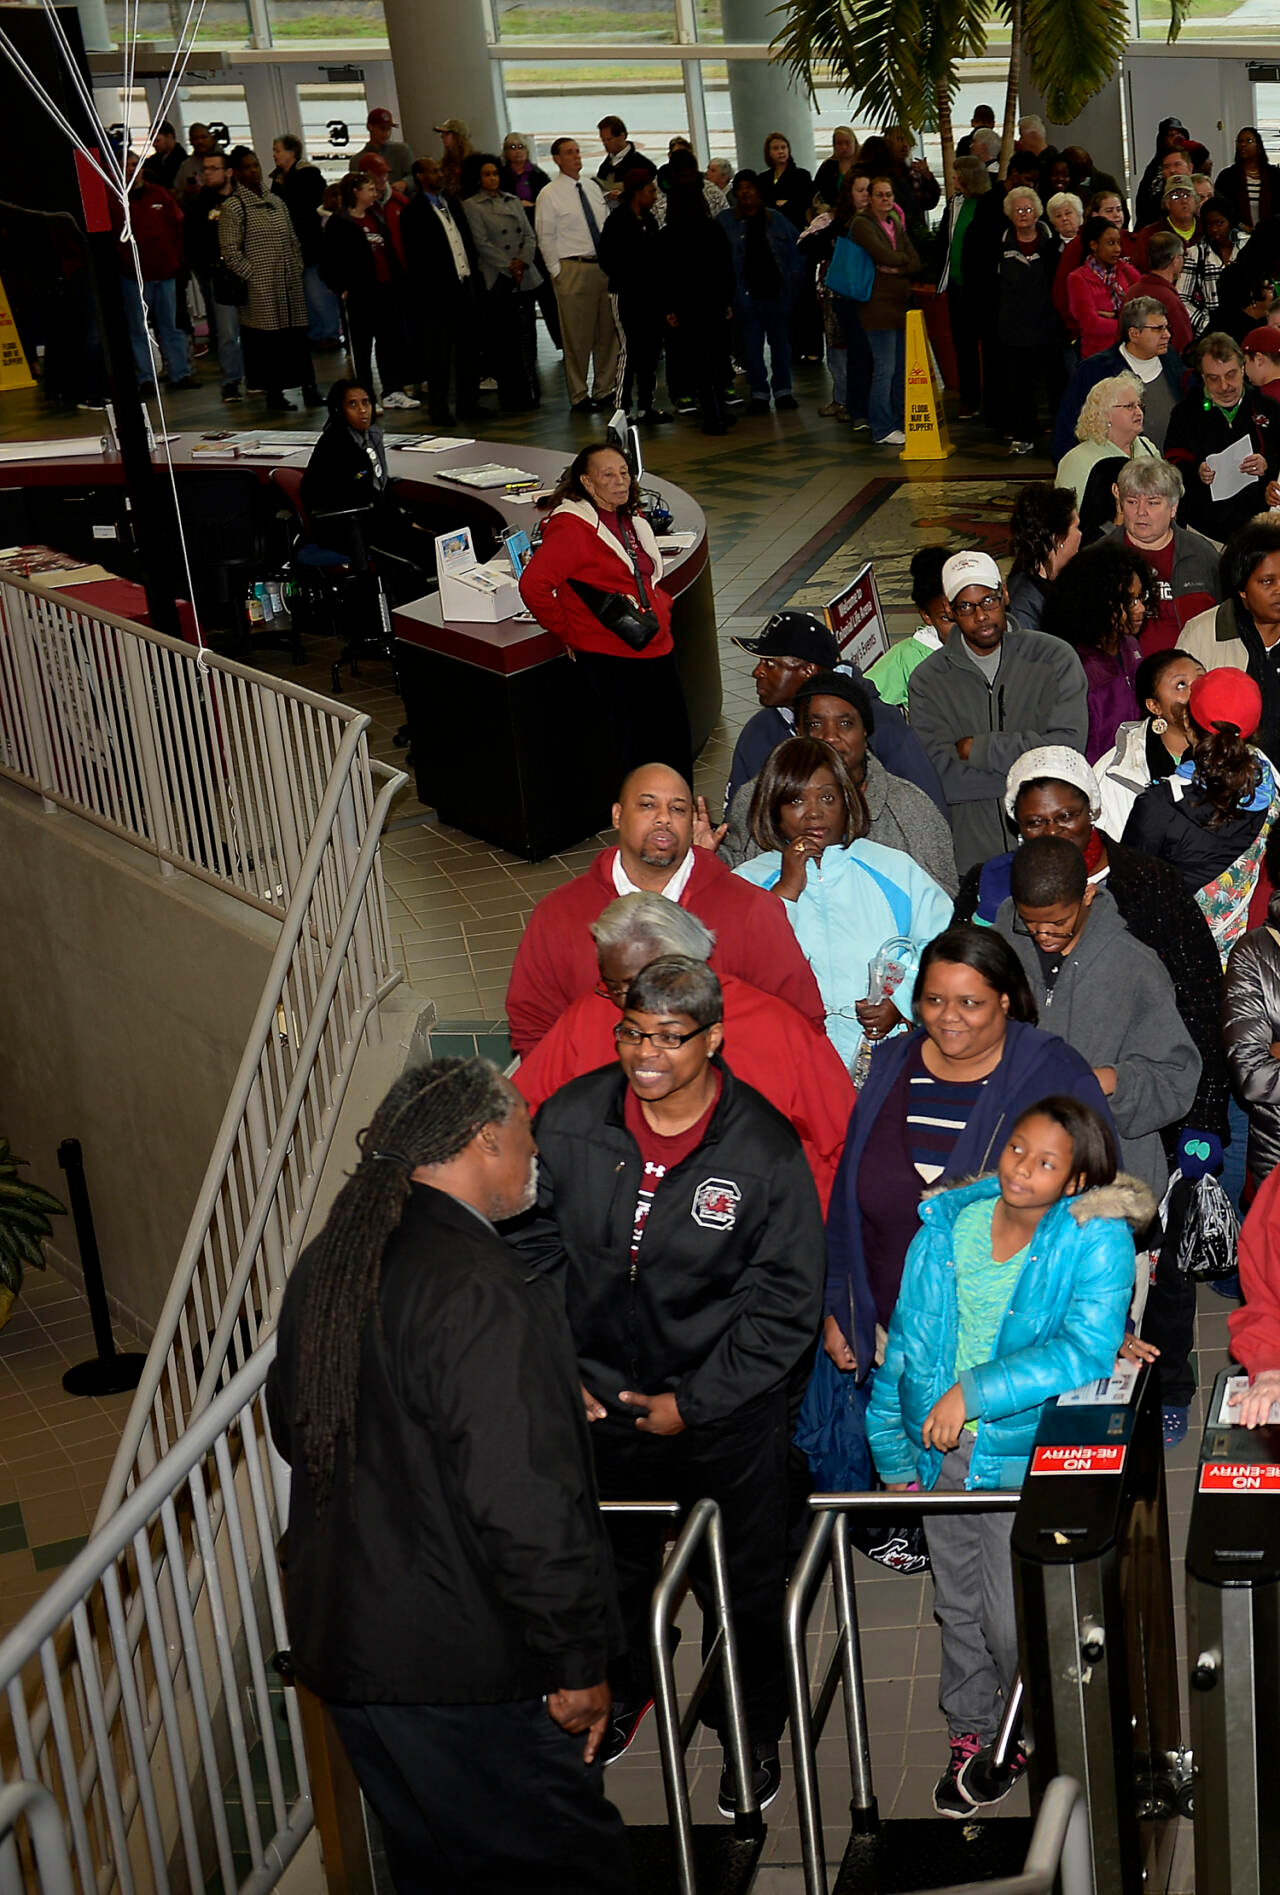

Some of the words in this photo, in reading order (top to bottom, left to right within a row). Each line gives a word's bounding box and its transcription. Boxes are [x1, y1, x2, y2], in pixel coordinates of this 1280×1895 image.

[911, 404, 929, 413] FLOOR
[911, 414, 923, 422] MAY
[923, 414, 931, 422] BE
[908, 423, 934, 432] SLIPPERY
[1042, 1448, 1118, 1459] RE-ENTRY
[1063, 1459, 1091, 1470] NO
[1232, 1477, 1260, 1488] NO
